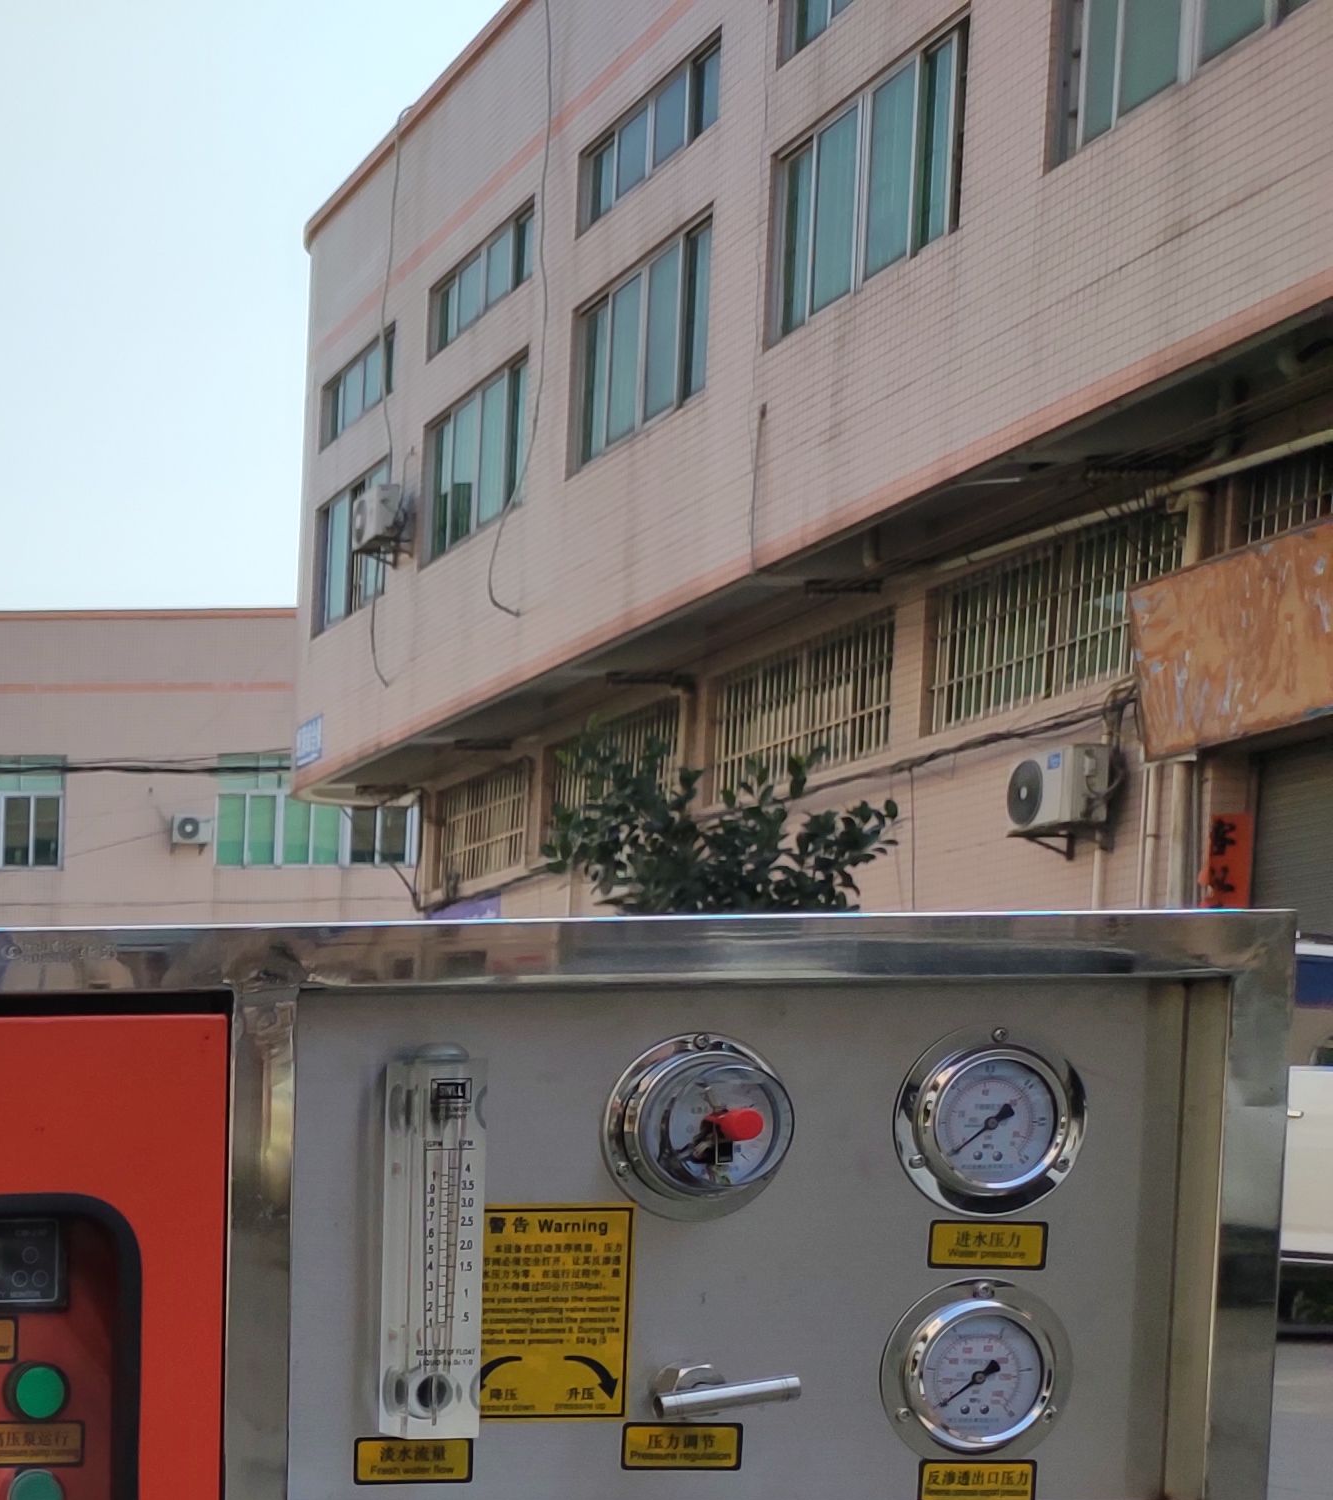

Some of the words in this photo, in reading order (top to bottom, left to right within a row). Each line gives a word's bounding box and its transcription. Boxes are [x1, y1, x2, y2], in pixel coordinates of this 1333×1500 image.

[538, 1219, 608, 1235] Warning
[956, 1231, 1021, 1248] 进水压力
[948, 1249, 978, 1258] Water
[566, 1388, 595, 1401] 升压
[647, 1434, 715, 1450] 压力调节
[927, 1470, 1028, 1486] 反渗透出口压力
